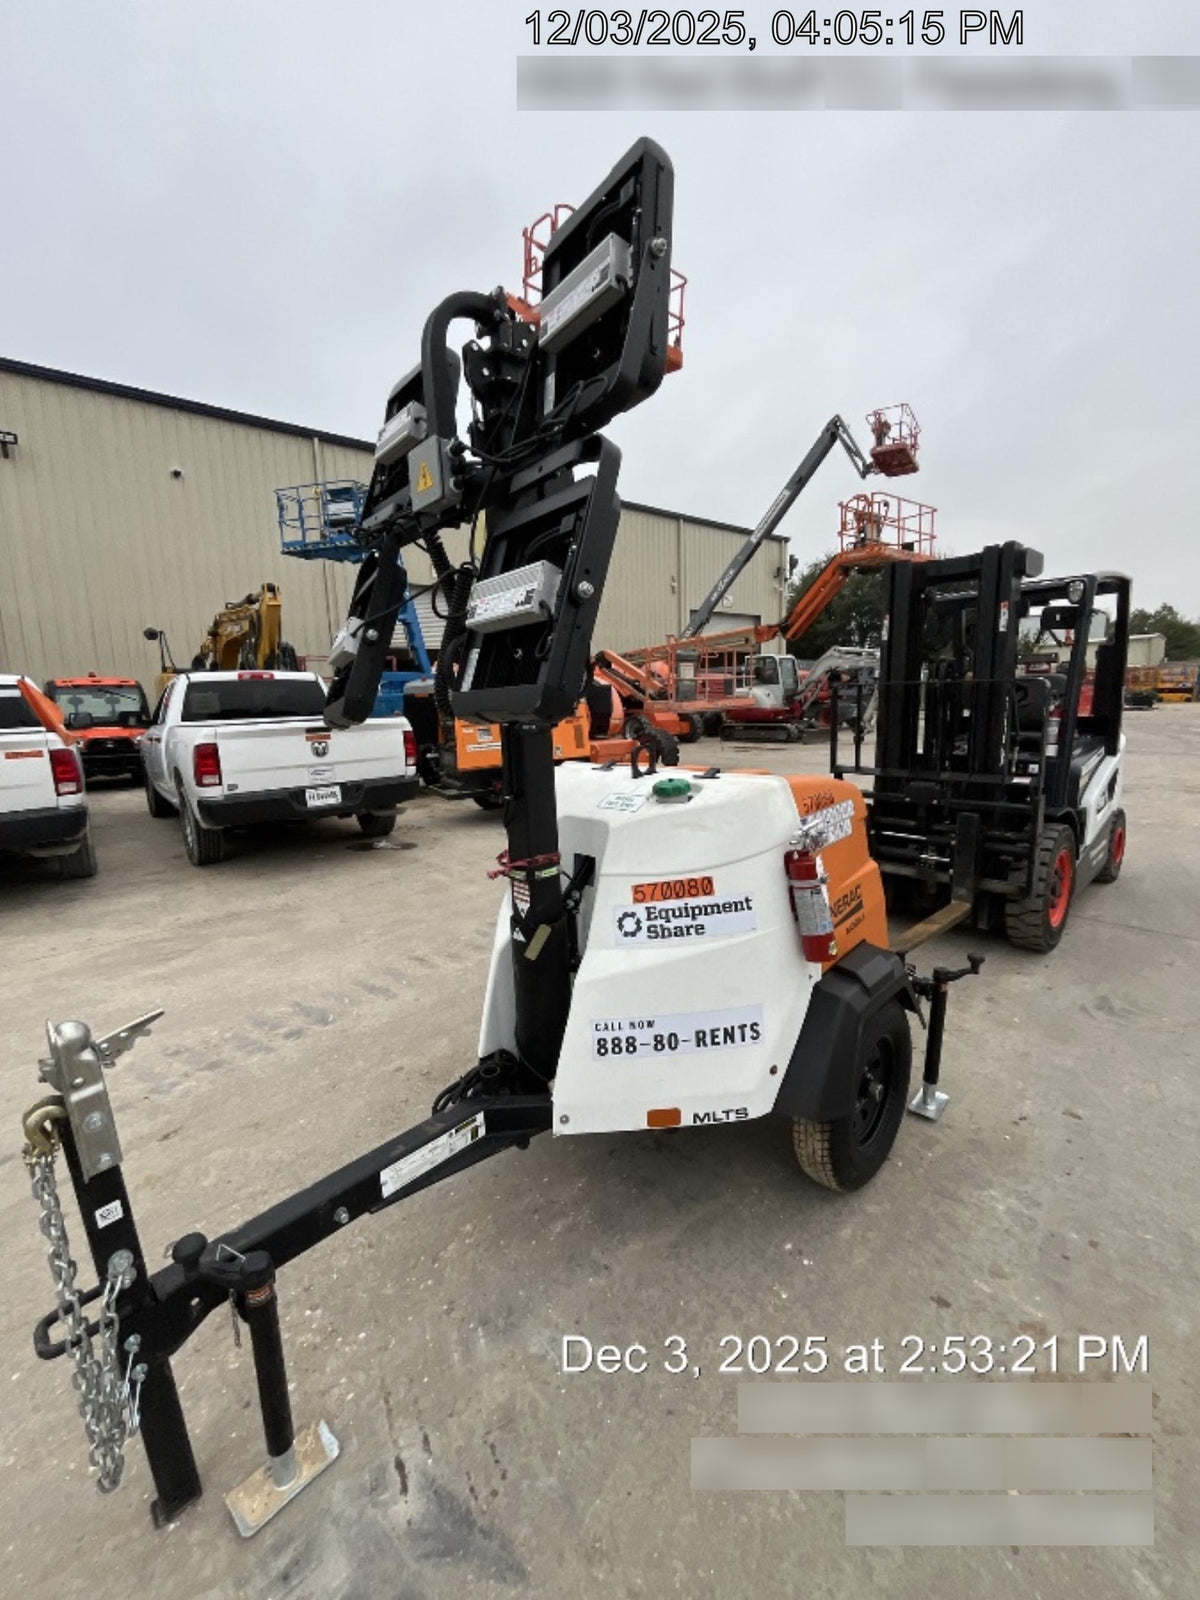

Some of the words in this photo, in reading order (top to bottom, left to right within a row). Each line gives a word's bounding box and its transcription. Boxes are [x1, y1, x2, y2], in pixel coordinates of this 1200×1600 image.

[633, 876, 714, 903] 570080
[645, 896, 753, 923] Equipment
[646, 923, 706, 940] Share
[595, 1021, 624, 1032] CALL
[629, 1019, 655, 1030] NOW
[596, 1022, 761, 1056] 888-80-RENTS
[692, 1107, 750, 1124] MLTS
